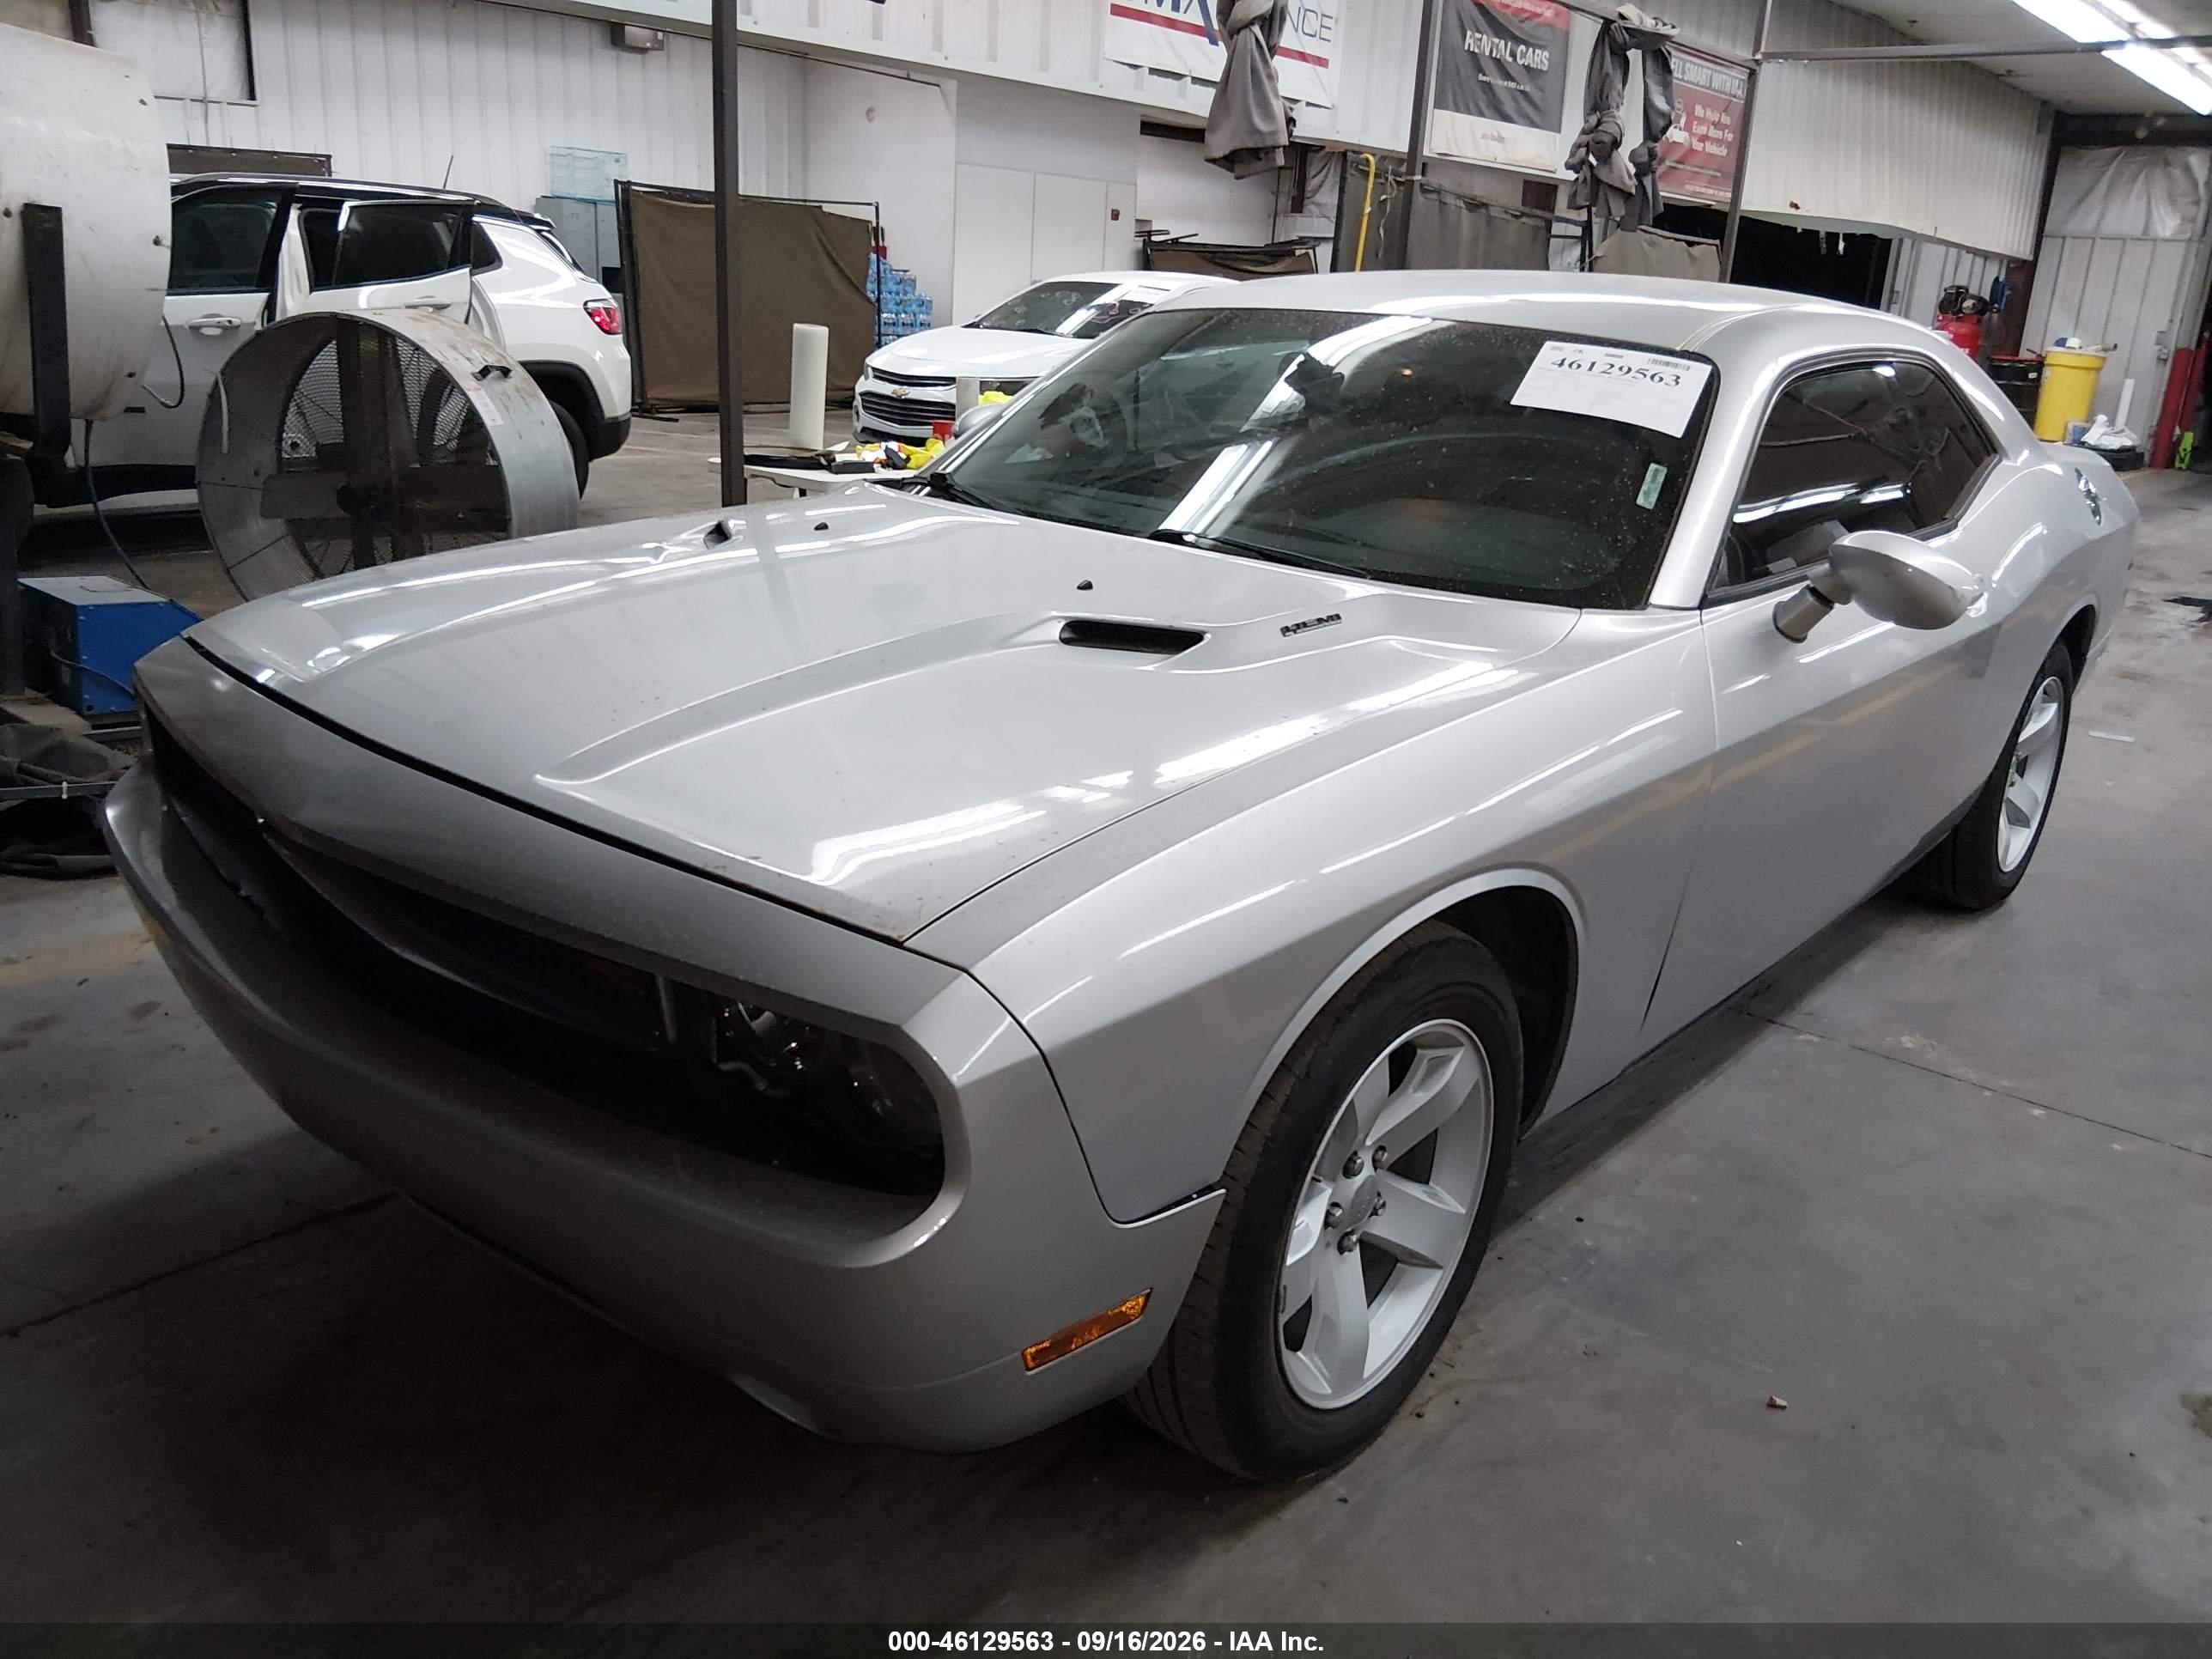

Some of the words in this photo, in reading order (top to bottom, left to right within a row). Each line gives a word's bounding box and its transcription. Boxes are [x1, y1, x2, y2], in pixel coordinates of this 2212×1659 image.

[1287, 7, 1334, 42] NCE
[1464, 29, 1512, 63] RENTAL
[1516, 45, 1549, 71] CARS
[1670, 56, 1683, 79] ELL
[1551, 356, 1681, 387] 46129563
